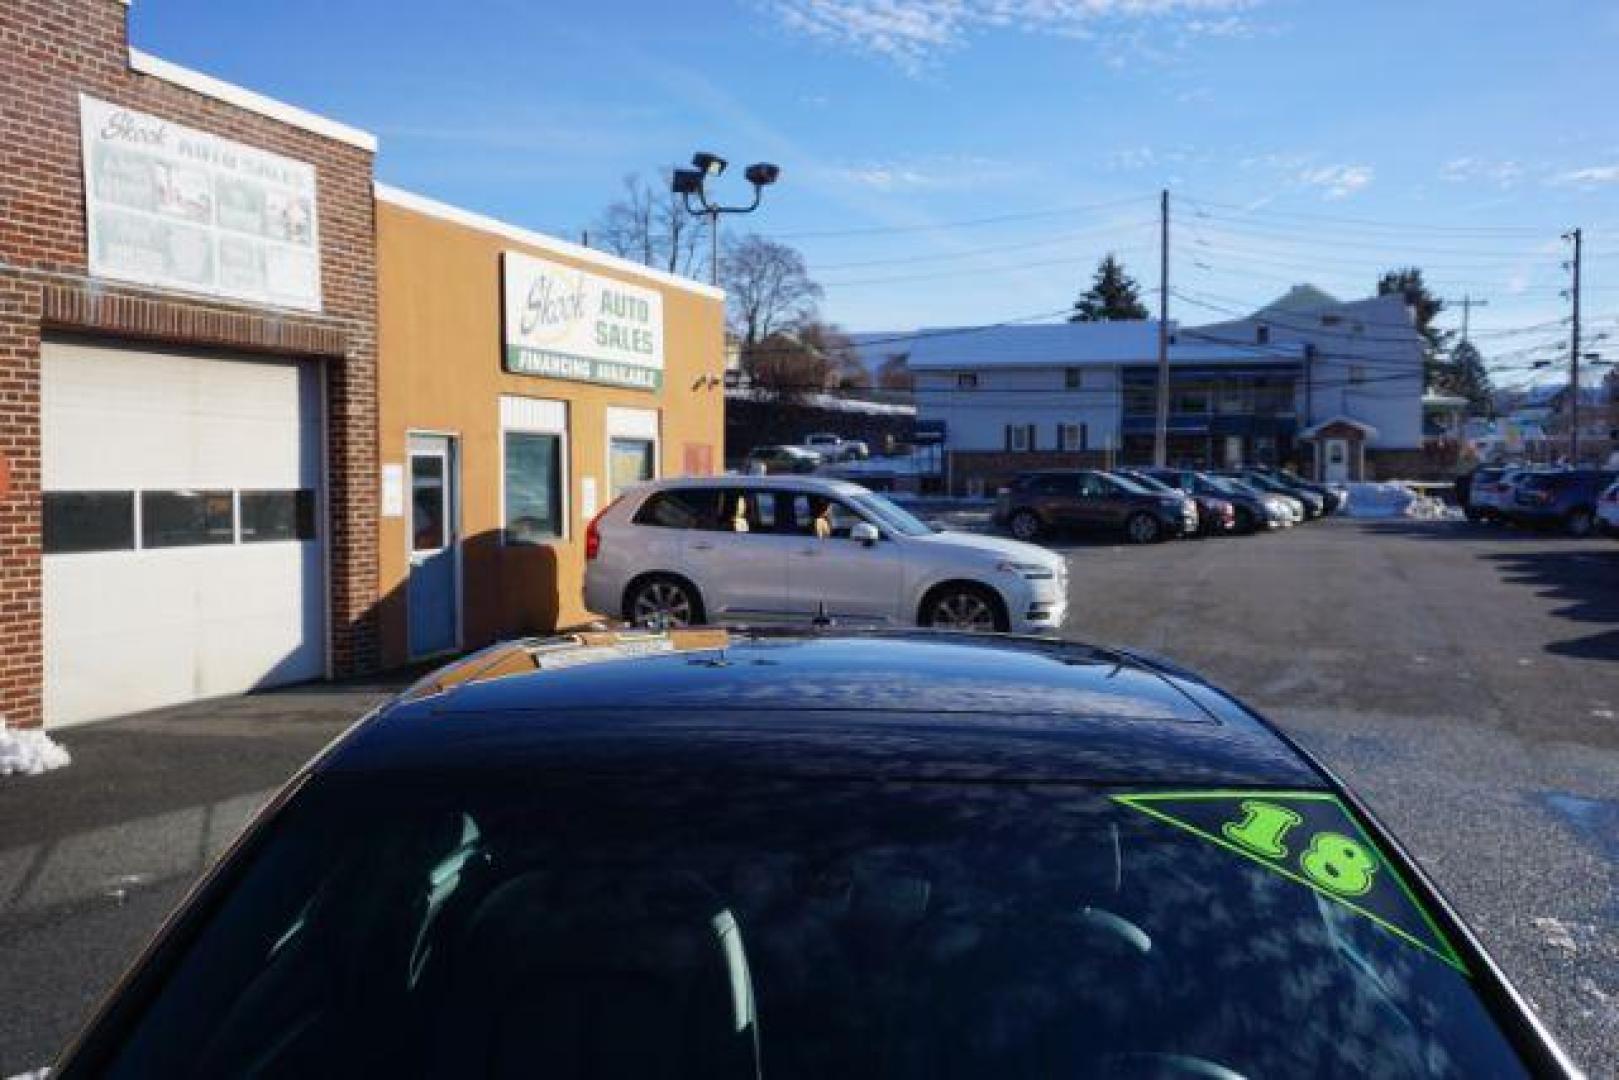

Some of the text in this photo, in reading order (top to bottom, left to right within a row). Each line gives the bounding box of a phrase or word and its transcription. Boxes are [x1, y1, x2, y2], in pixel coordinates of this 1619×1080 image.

[601, 290, 649, 322] AUTO
[595, 320, 654, 355] SALES
[1221, 800, 1379, 897] 18
